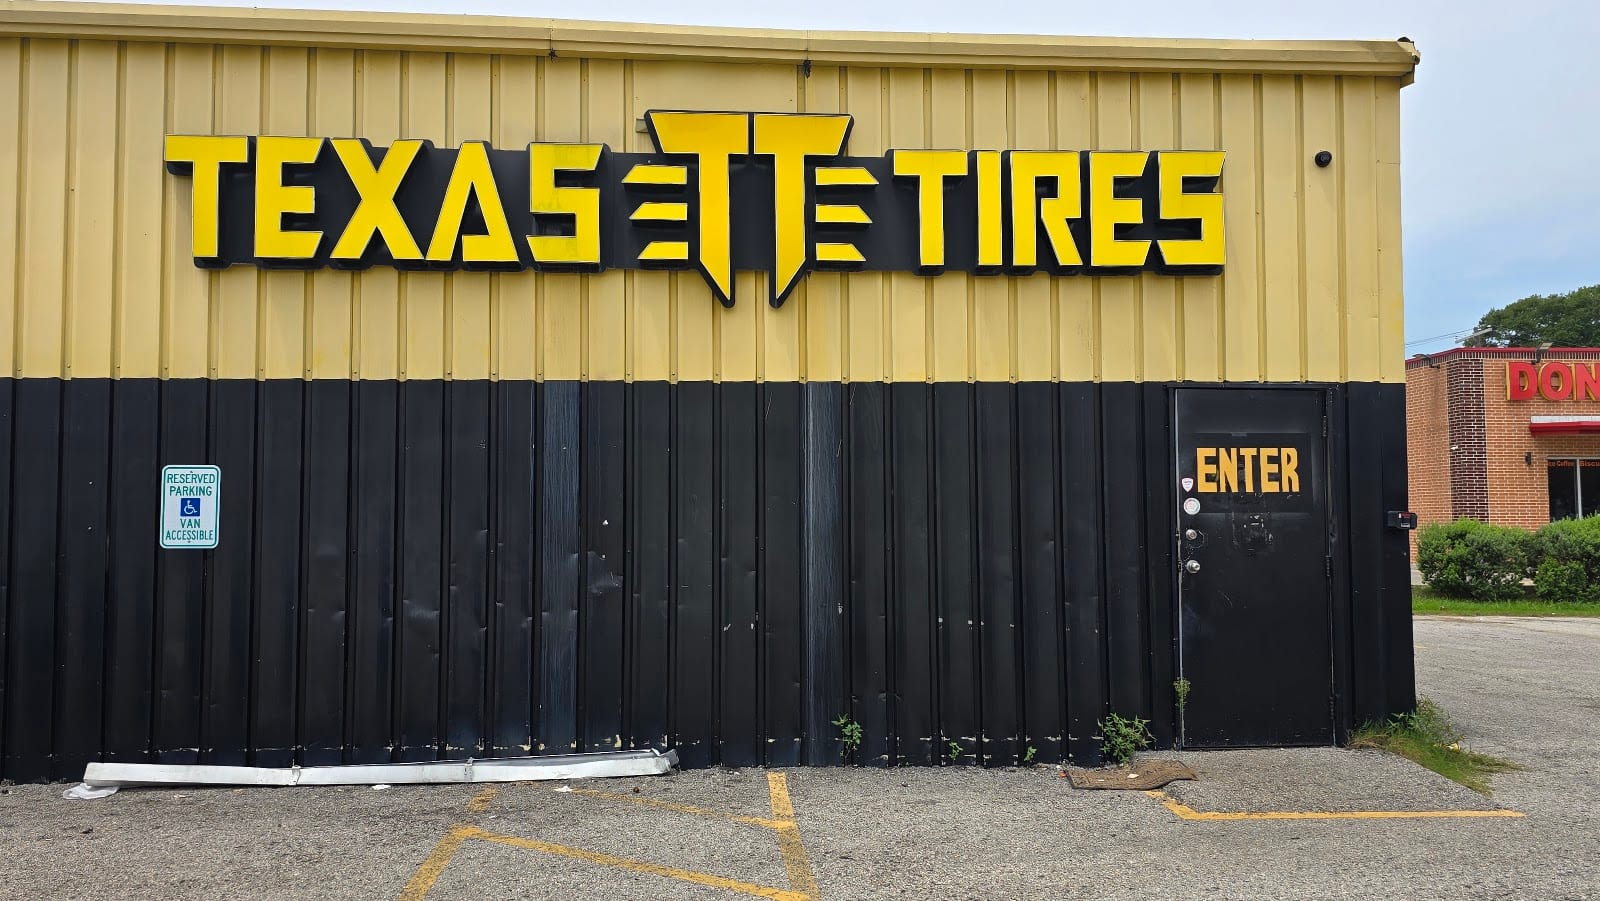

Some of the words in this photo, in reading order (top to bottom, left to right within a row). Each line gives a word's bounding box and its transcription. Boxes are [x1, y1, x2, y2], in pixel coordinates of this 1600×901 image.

[164, 135, 604, 264] TEXAS
[893, 150, 1227, 267] TIRES
[1505, 361, 1600, 401] DON
[1196, 447, 1300, 493] ENTER
[167, 473, 216, 484] RESERVED
[169, 485, 212, 497] PARKING
[180, 518, 201, 529] VAN
[165, 530, 214, 541] ACCESSIBLE
